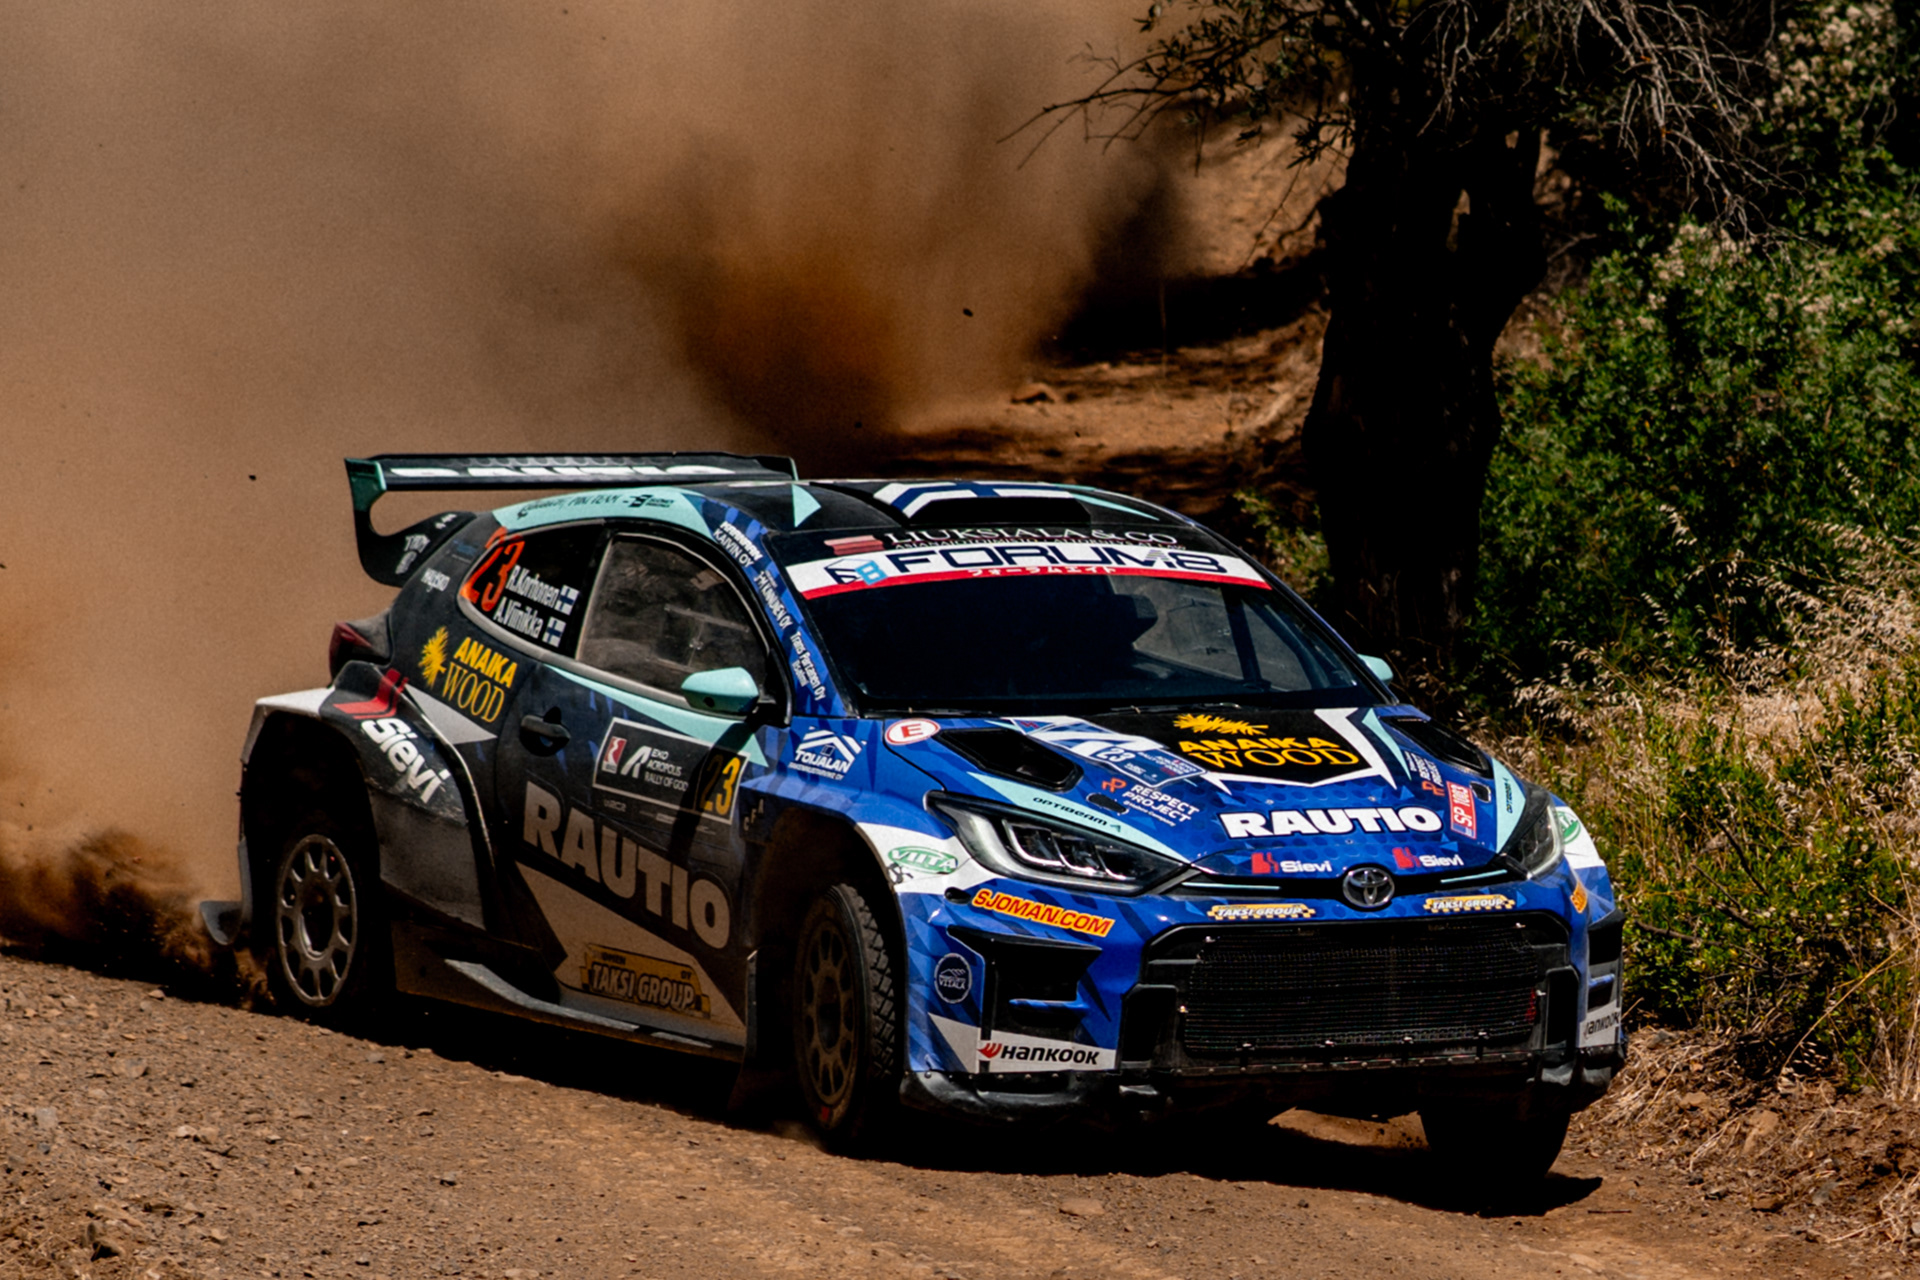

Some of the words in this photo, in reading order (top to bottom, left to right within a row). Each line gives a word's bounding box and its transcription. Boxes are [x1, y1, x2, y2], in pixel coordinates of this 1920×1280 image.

[460, 526, 526, 613] 23
[886, 545, 1228, 574] FORUM8
[453, 636, 518, 689] ANAIKA
[441, 661, 505, 724] WOOD
[901, 723, 924, 739] E
[1178, 737, 1341, 753] ANAIKA
[360, 717, 451, 804] Sievi
[646, 759, 683, 777] ACROPOLIS
[1096, 747, 1136, 763] 23
[1187, 748, 1360, 769] WOOD
[1122, 791, 1192, 823] PROJECT
[1130, 784, 1200, 815] RESPECT
[1219, 806, 1443, 840] RAUTIO
[523, 780, 730, 949] RAUTIO
[1280, 860, 1333, 873] Sievi
[1419, 854, 1465, 868] Sievi
[974, 889, 1114, 935] SJOMAN.COM
[1218, 908, 1255, 917] TAKSI
[1256, 907, 1303, 915] GROUP
[1432, 900, 1466, 910] TAKSI
[1467, 899, 1504, 908] GROUP
[592, 961, 636, 998] TAKSI
[637, 973, 695, 1010] GROUP
